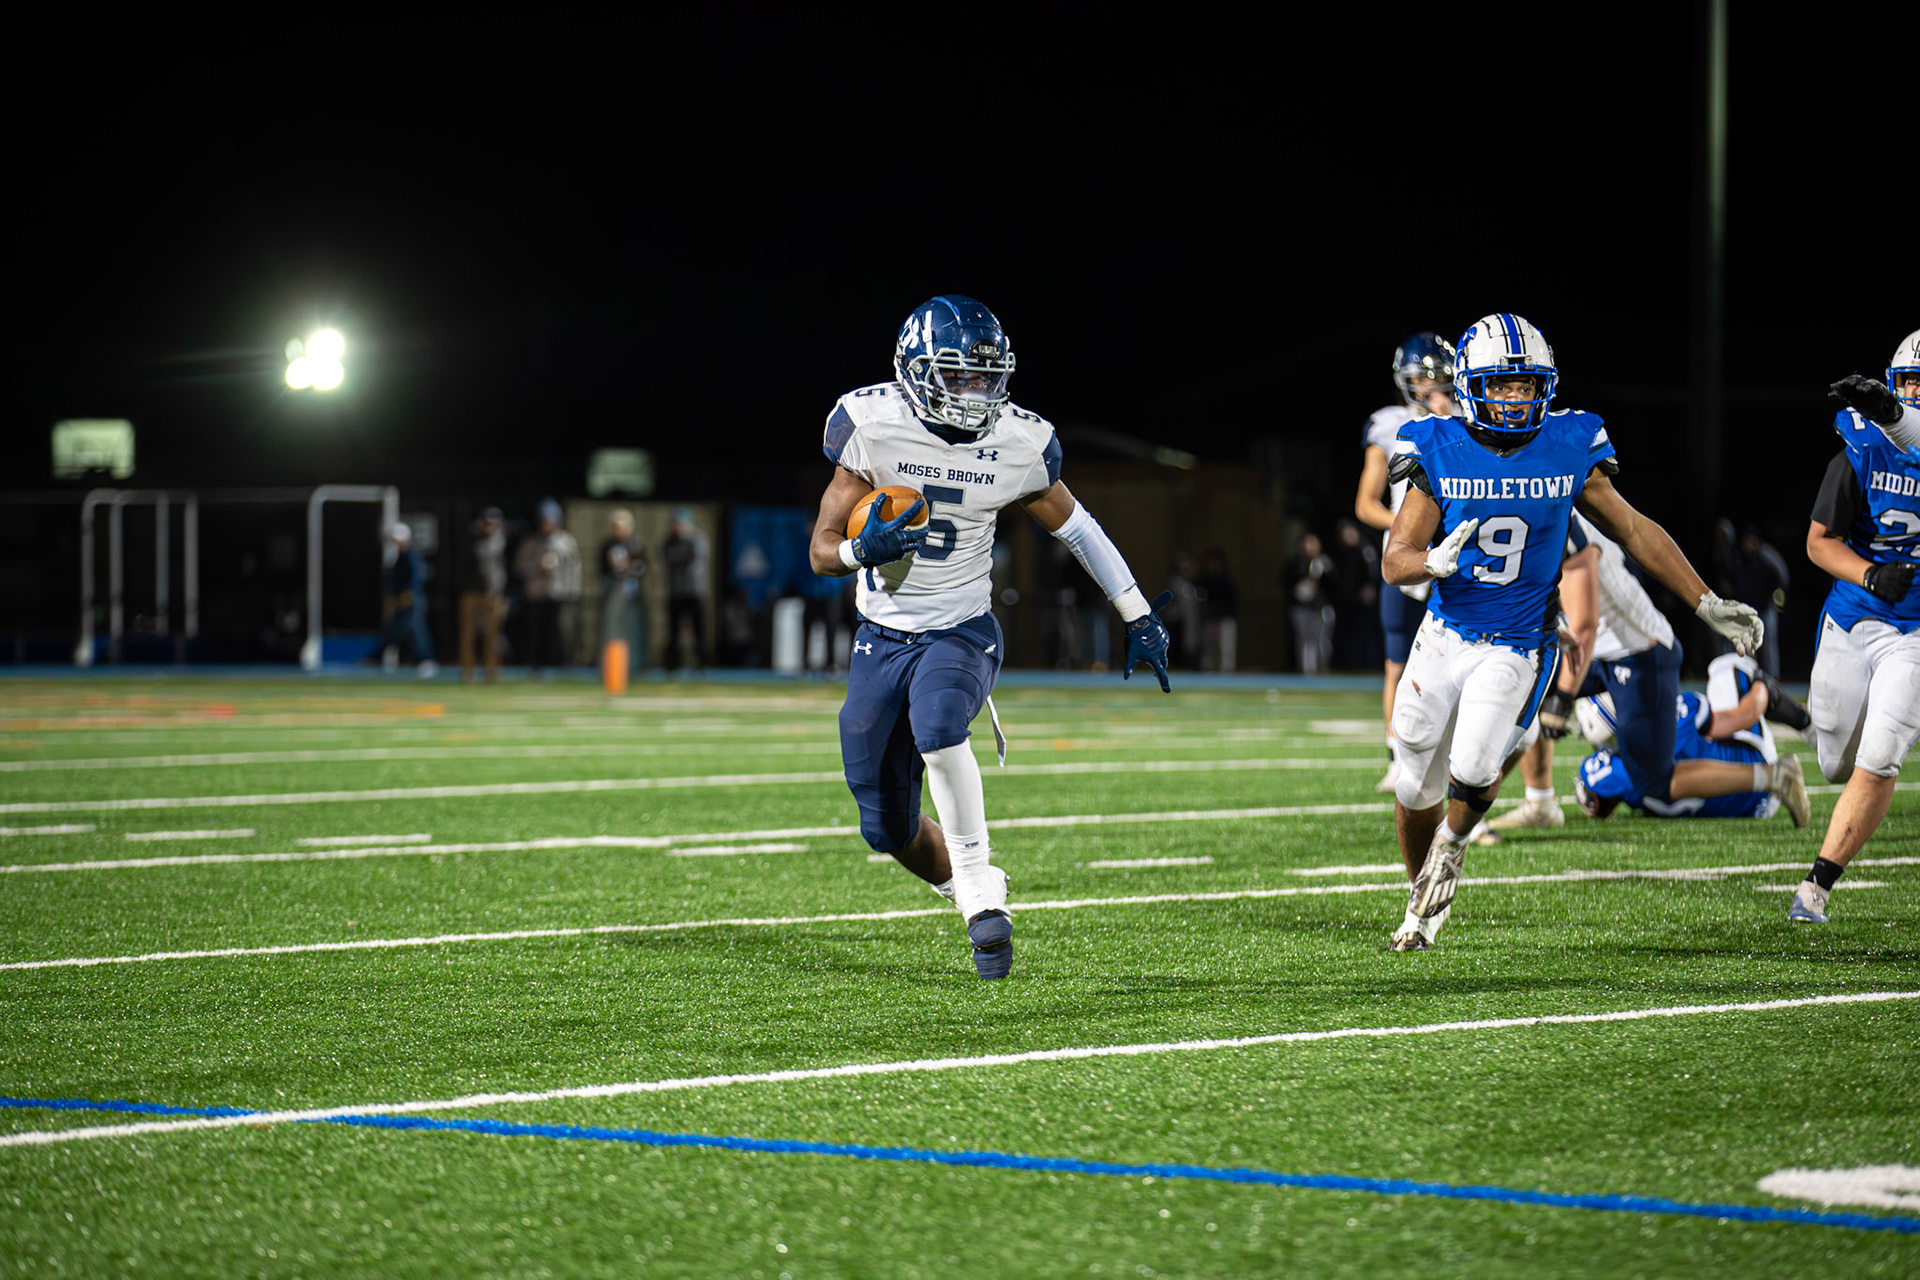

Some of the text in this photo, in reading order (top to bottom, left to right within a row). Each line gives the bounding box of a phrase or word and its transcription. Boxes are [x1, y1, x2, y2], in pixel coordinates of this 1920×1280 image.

[897, 462, 995, 485] MOSES BROWN
[1439, 475, 1574, 499] MIDDLETOWN
[916, 483, 966, 562] 5
[1472, 516, 1530, 587] 9
